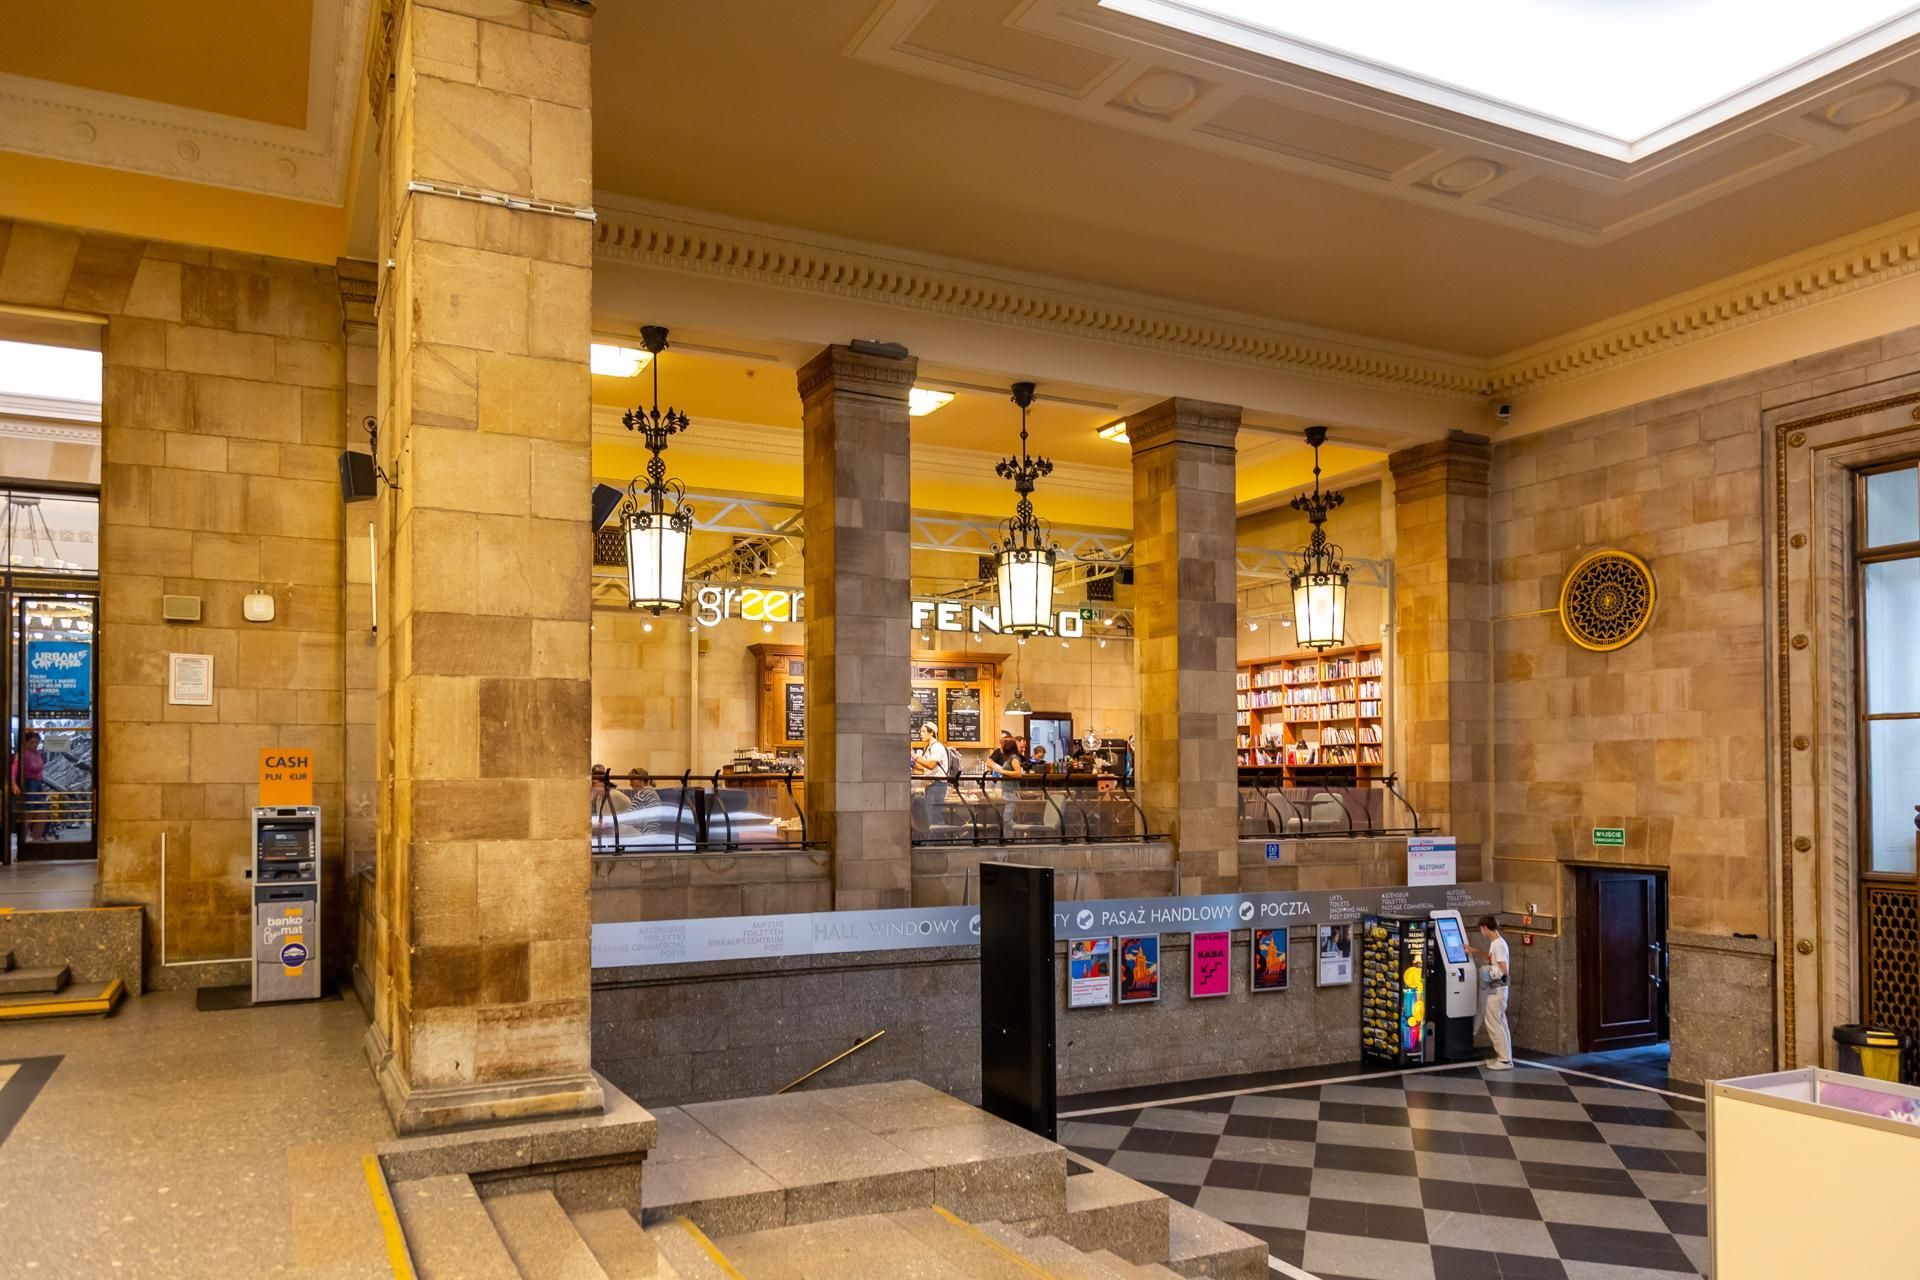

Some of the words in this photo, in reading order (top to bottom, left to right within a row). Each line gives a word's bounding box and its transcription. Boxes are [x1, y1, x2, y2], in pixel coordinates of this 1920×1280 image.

[970, 606, 1083, 638] NO
[35, 652, 78, 661] URBAN
[265, 756, 308, 768] CASH
[1260, 902, 1311, 917] POCZTA
[1102, 905, 1146, 926] PASAŻ
[1151, 905, 1234, 923] HANDLOWY
[267, 916, 303, 926] banko
[752, 920, 784, 929] AUFZUG
[281, 926, 303, 935] mat
[742, 928, 784, 937] TOILETTEN
[814, 924, 858, 941] HALL
[868, 919, 960, 937] WINDOWY
[707, 936, 784, 947] EINKAUFSZENTRUM
[763, 944, 783, 952] POST
[1197, 950, 1225, 959] KASA
